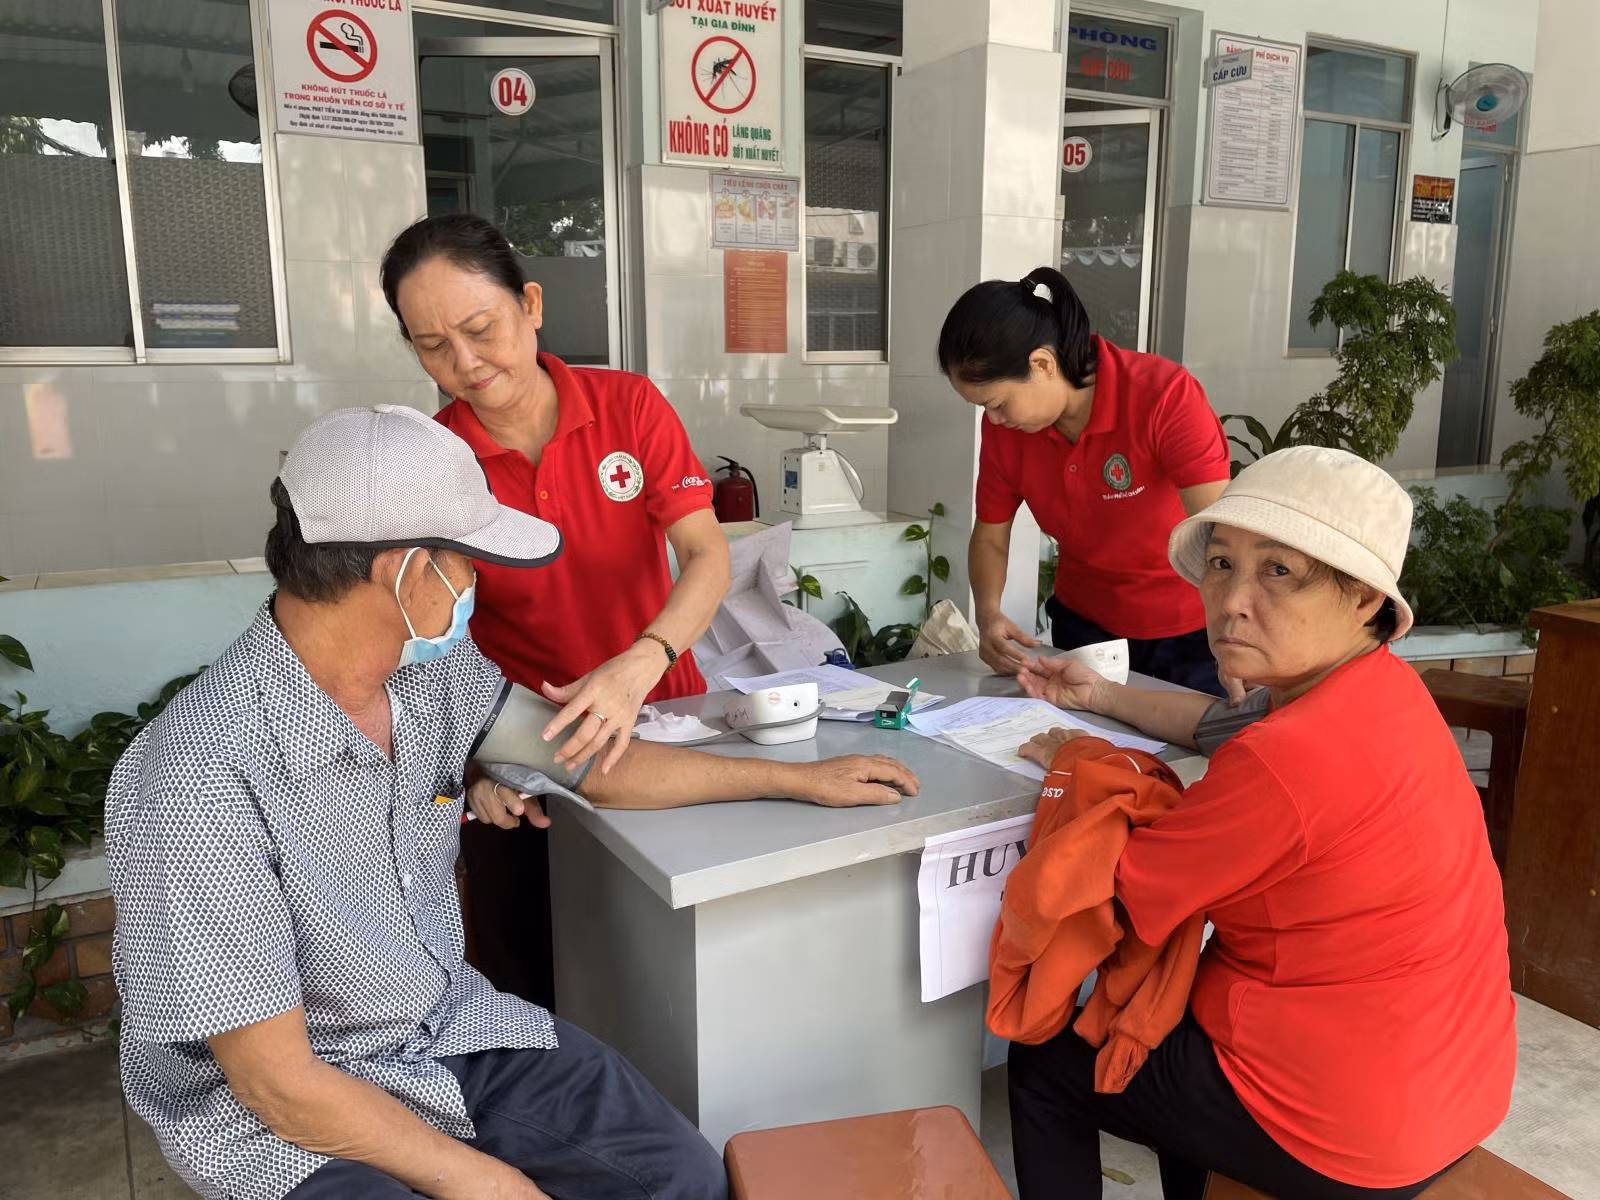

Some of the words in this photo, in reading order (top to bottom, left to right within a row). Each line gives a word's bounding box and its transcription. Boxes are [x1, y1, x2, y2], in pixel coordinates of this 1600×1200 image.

[735, 1, 777, 21] HUYẾT
[691, 16, 708, 29] TẠI
[711, 19, 728, 30] GIA
[731, 20, 755, 33] ĐÌNH
[1213, 67, 1229, 81] CẤP
[1231, 65, 1247, 78] CỨU
[301, 84, 329, 93] KHÔNG
[331, 85, 346, 95] HÚT
[350, 88, 375, 98] THUỐC
[378, 90, 388, 99] LÁ
[498, 77, 527, 107] 04
[284, 93, 311, 102] TRONG
[313, 94, 341, 104] KHUÔN
[343, 98, 360, 107] VIÊN
[363, 99, 374, 109] CƠ
[376, 101, 386, 110] SỞ
[395, 102, 405, 112] TẾ
[669, 115, 710, 156] KHÔNG
[713, 118, 729, 158] CÓ
[733, 144, 744, 159] SỐT
[1063, 143, 1086, 167] 05
